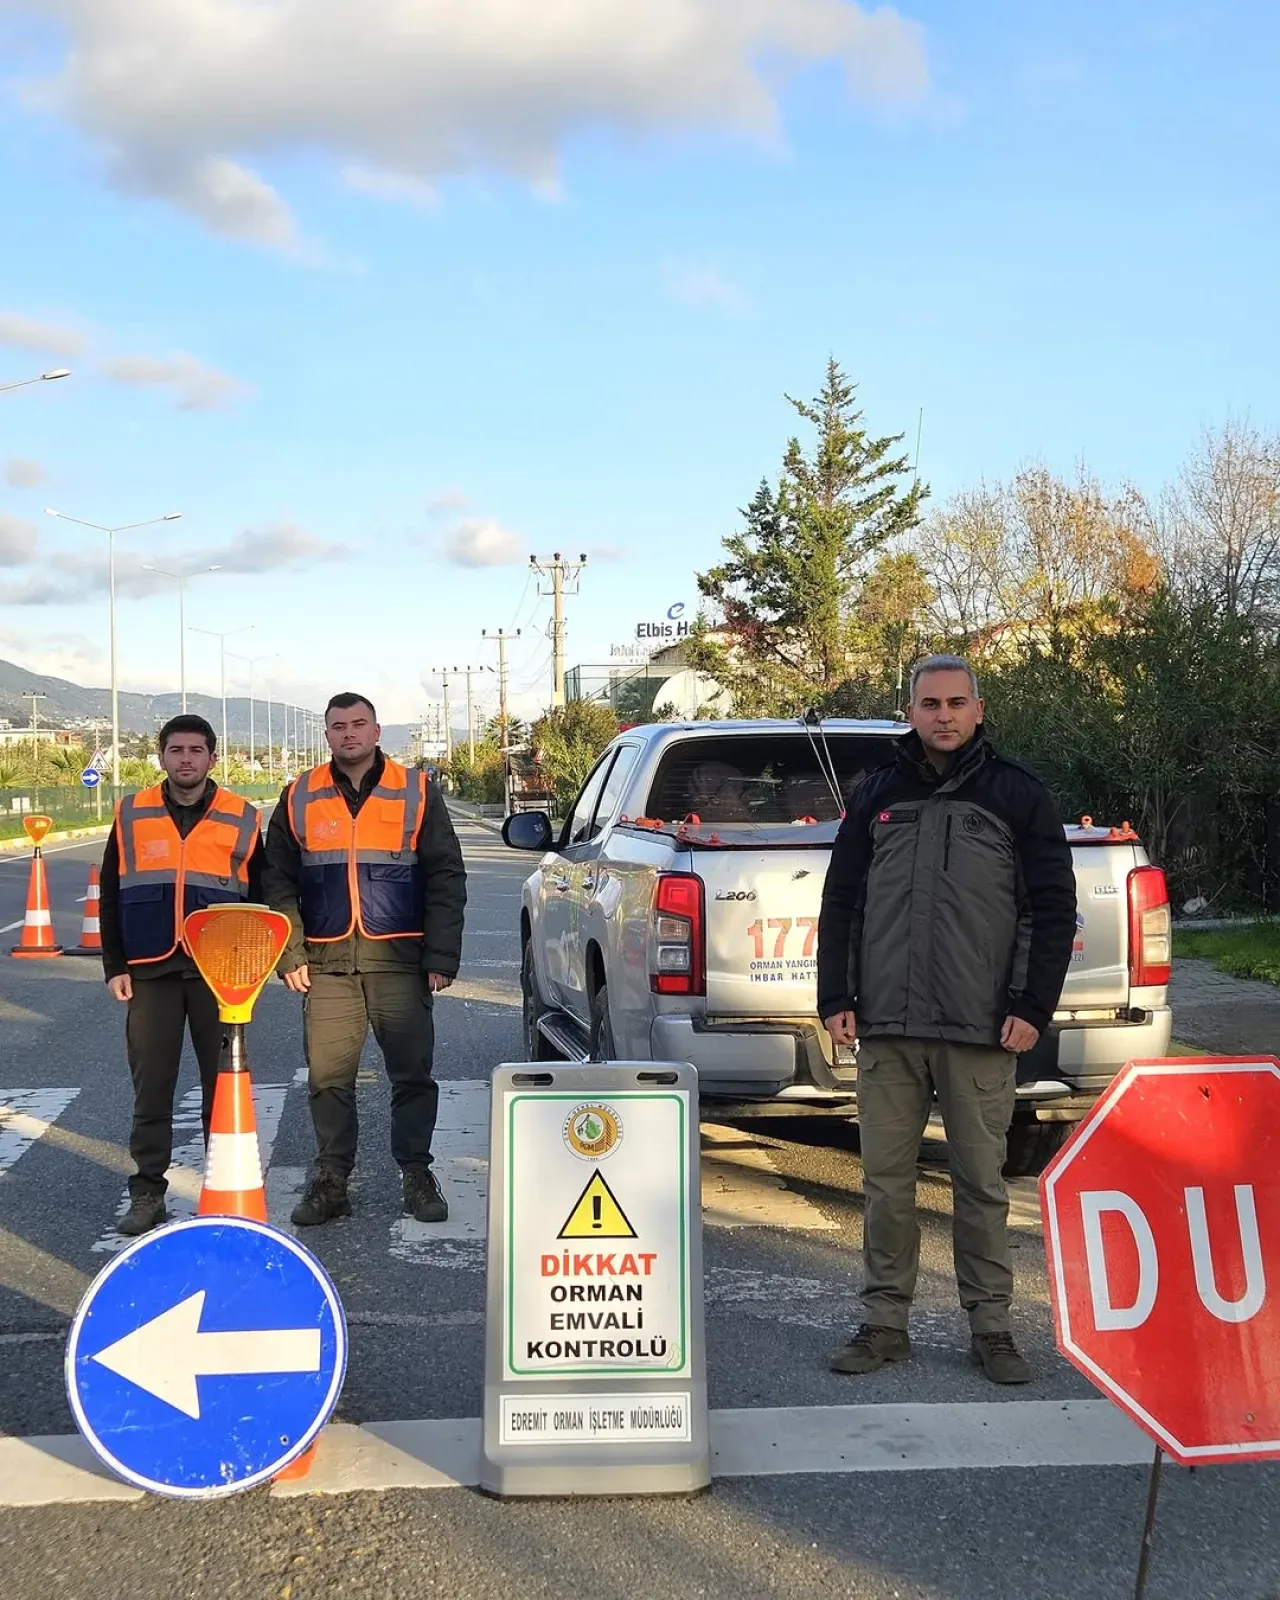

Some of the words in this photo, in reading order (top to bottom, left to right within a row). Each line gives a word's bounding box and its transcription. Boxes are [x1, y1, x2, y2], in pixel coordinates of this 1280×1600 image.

[637, 622, 673, 638] Elbis
[715, 888, 757, 901] L200
[747, 916, 819, 959] 177
[750, 961, 783, 970] ORMAN
[541, 1249, 657, 1277] DİKKAT
[550, 1284, 642, 1302] ORMAN
[550, 1308, 643, 1330] EMVALİ
[527, 1336, 667, 1359] KONTROLÜ
[511, 1408, 548, 1431] EDREMİT
[553, 1411, 584, 1430] ORMAN
[589, 1406, 624, 1434] İŞLETME
[630, 1406, 682, 1429] MÜDÜRLÜĞÜ
